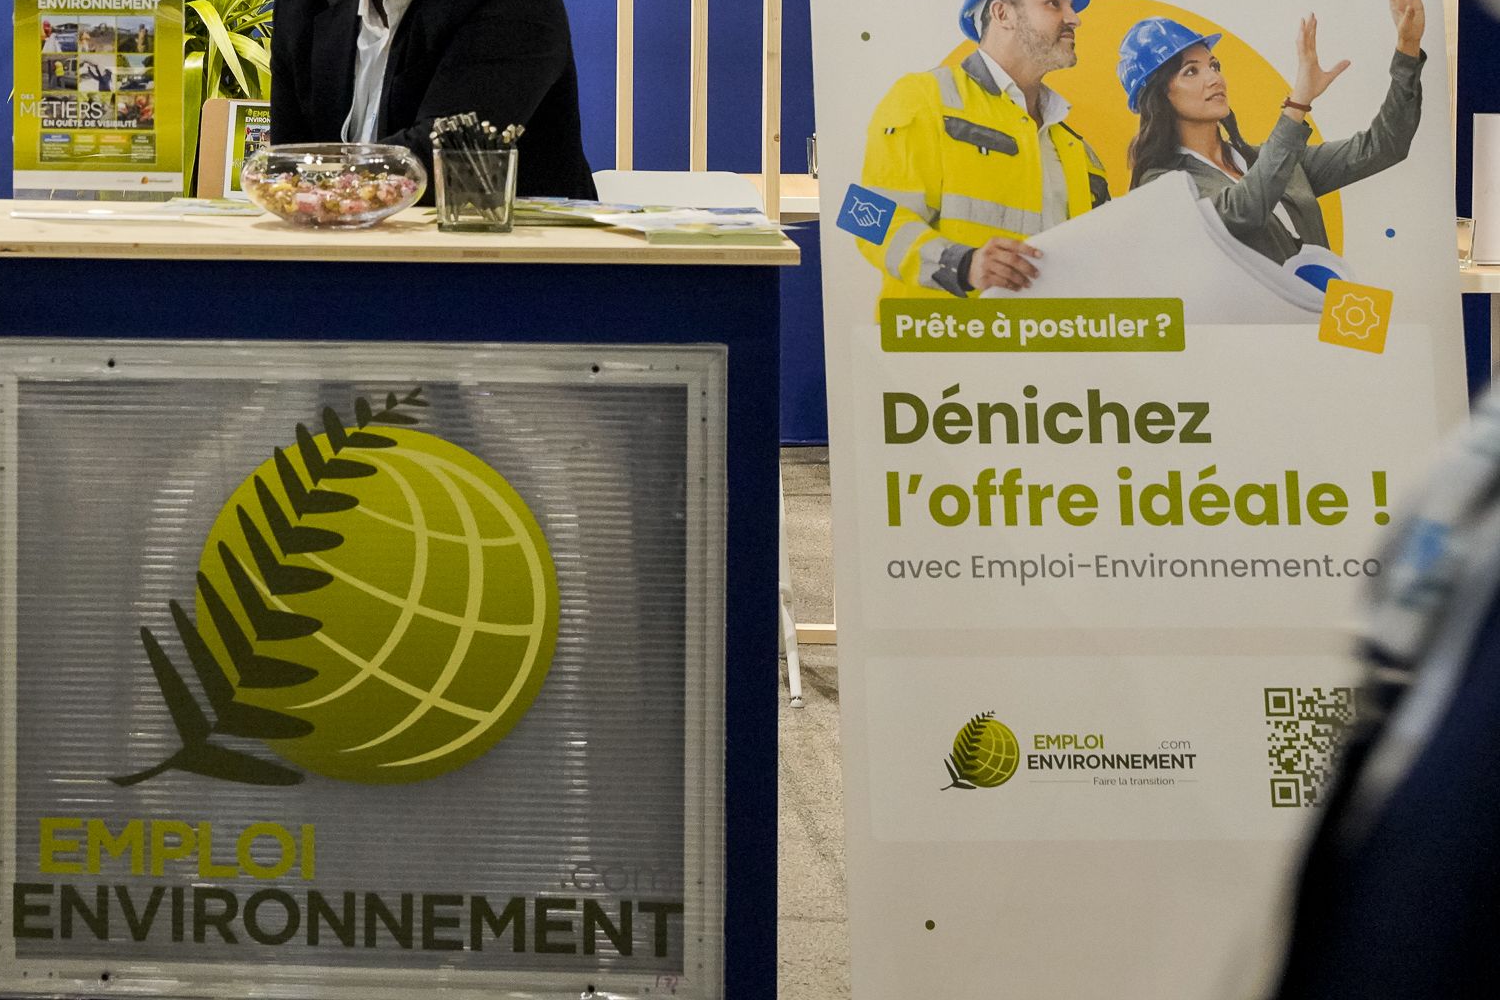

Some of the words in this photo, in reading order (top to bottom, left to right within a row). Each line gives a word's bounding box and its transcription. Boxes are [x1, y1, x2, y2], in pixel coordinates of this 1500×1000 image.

[20, 98, 103, 119] MÉTIERS
[43, 119, 55, 127] EN
[56, 118, 83, 128] QUÊTE
[84, 120, 96, 128] DE
[97, 119, 138, 128] VISIBILITÉ
[992, 312, 1011, 338] à
[1019, 313, 1149, 346] postuler
[1156, 314, 1171, 338] ?
[883, 383, 1212, 445] Dénichez
[887, 466, 1099, 527] l’offre
[1117, 464, 1348, 526] idéale
[1372, 470, 1391, 525] !
[887, 558, 961, 580] avec
[1034, 734, 1104, 750] EMPLOI
[1158, 738, 1191, 749] .com
[1027, 754, 1196, 770] ENVIRONNEMENT
[1093, 776, 1117, 786] Faire
[1119, 776, 1128, 786] la
[1130, 776, 1175, 786] transition
[39, 817, 316, 880] EMPLOI
[13, 882, 685, 958] ENVIRONNEMENT
